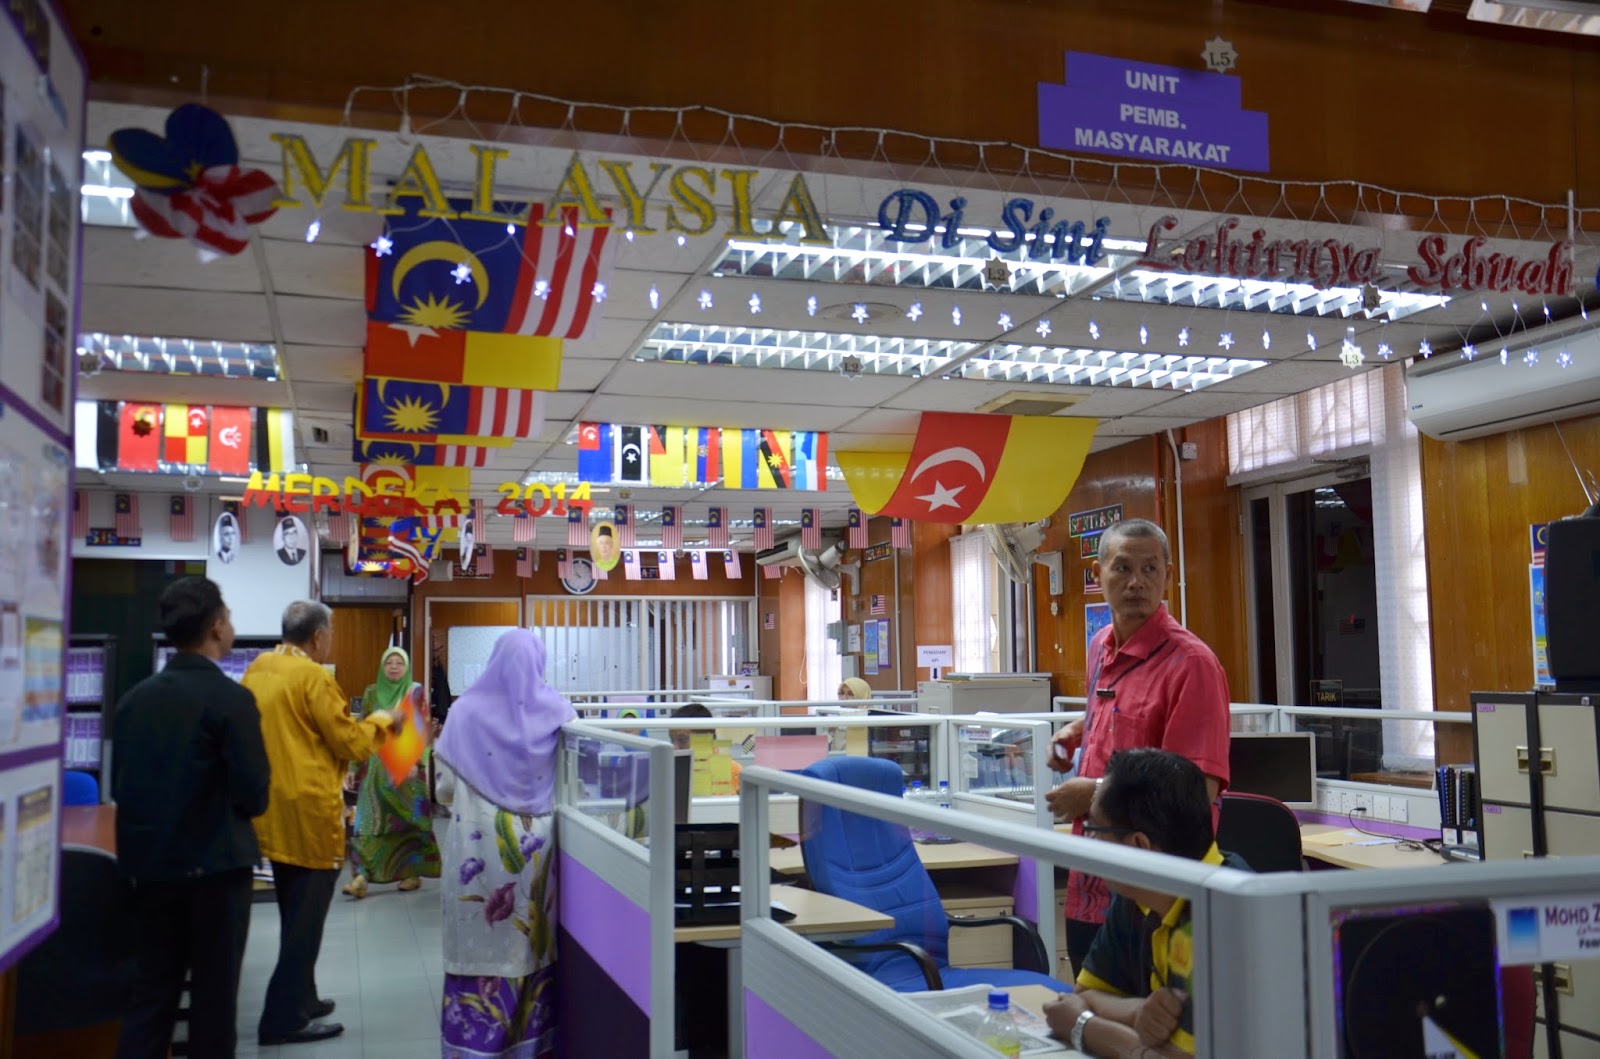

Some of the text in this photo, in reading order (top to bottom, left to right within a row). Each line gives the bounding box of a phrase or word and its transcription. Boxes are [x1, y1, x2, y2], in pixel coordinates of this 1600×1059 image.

[1125, 70, 1180, 94] UNIT
[1120, 103, 1187, 130] PEMB.
[1075, 128, 1230, 163] MASYARAKAT
[270, 132, 1575, 296] MALAYSIA Di Sini Lahirnya Sebuah
[1345, 354, 1359, 364] L3
[242, 471, 594, 517] MERDEKA 2014
[1316, 691, 1337, 702] TARIK
